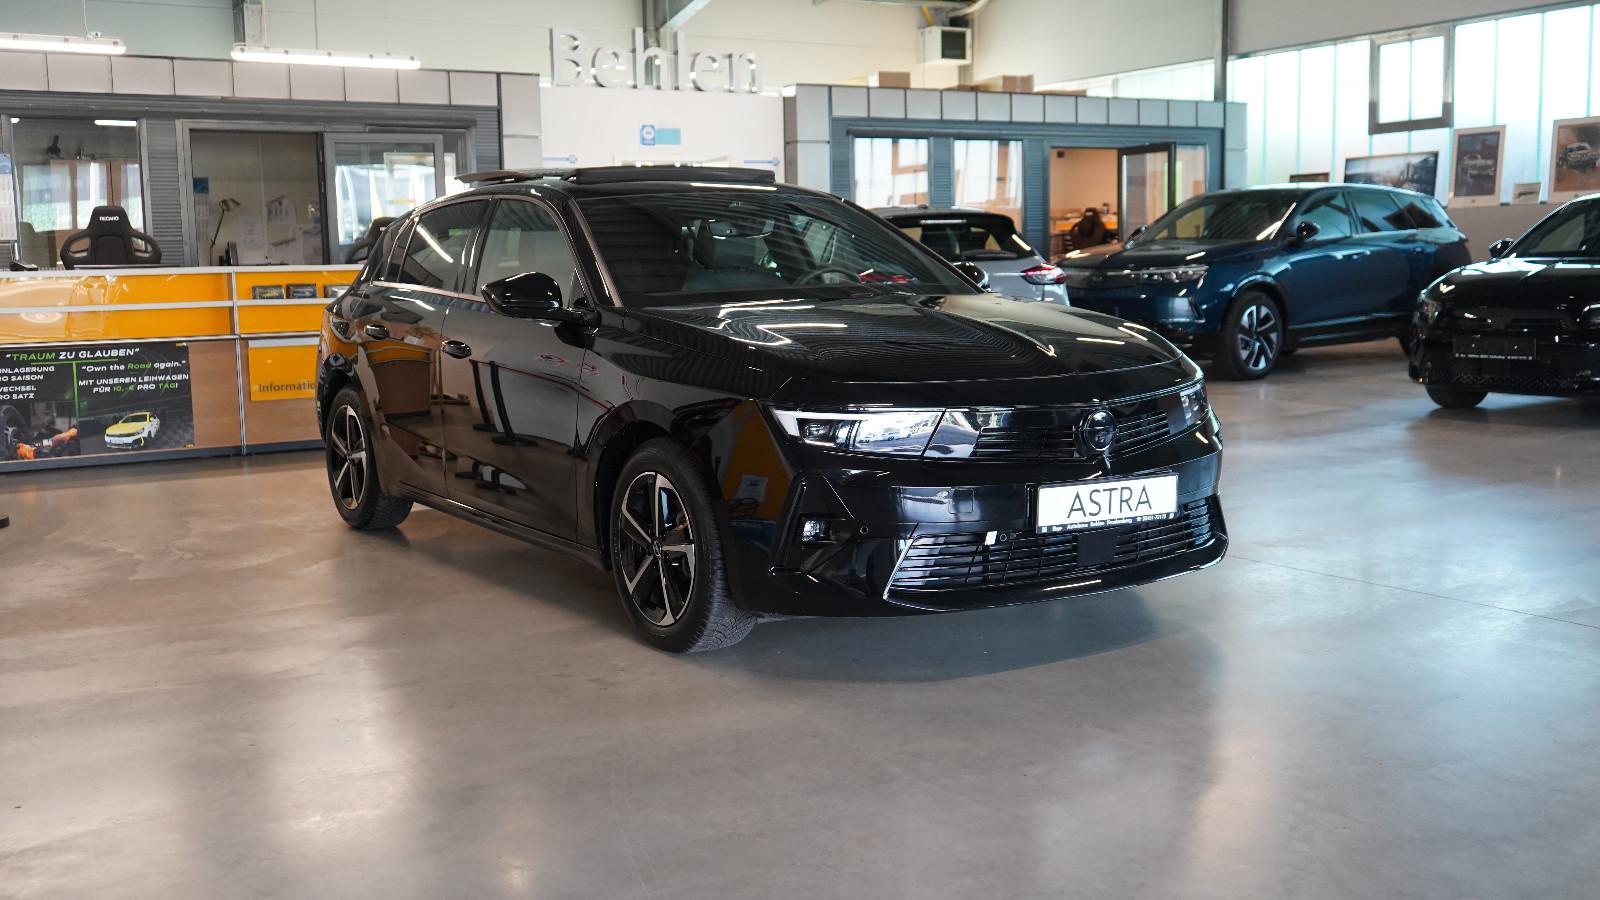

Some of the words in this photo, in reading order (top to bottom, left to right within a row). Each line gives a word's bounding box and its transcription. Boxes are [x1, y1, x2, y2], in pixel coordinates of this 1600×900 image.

[549, 26, 763, 94] Behlen
[58, 351, 76, 360] ZU
[127, 361, 152, 370] Road
[10, 374, 44, 382] SAISON
[78, 379, 95, 387] MIT
[96, 376, 137, 386] UNSEREN
[138, 373, 189, 383] LEIHWAGEN
[93, 385, 111, 394] FÜR
[137, 383, 156, 391] PRO
[158, 381, 179, 390] TAG!
[259, 381, 316, 392] Informatio
[12, 392, 35, 400] SATZ
[1067, 485, 1152, 518] ASTRA
